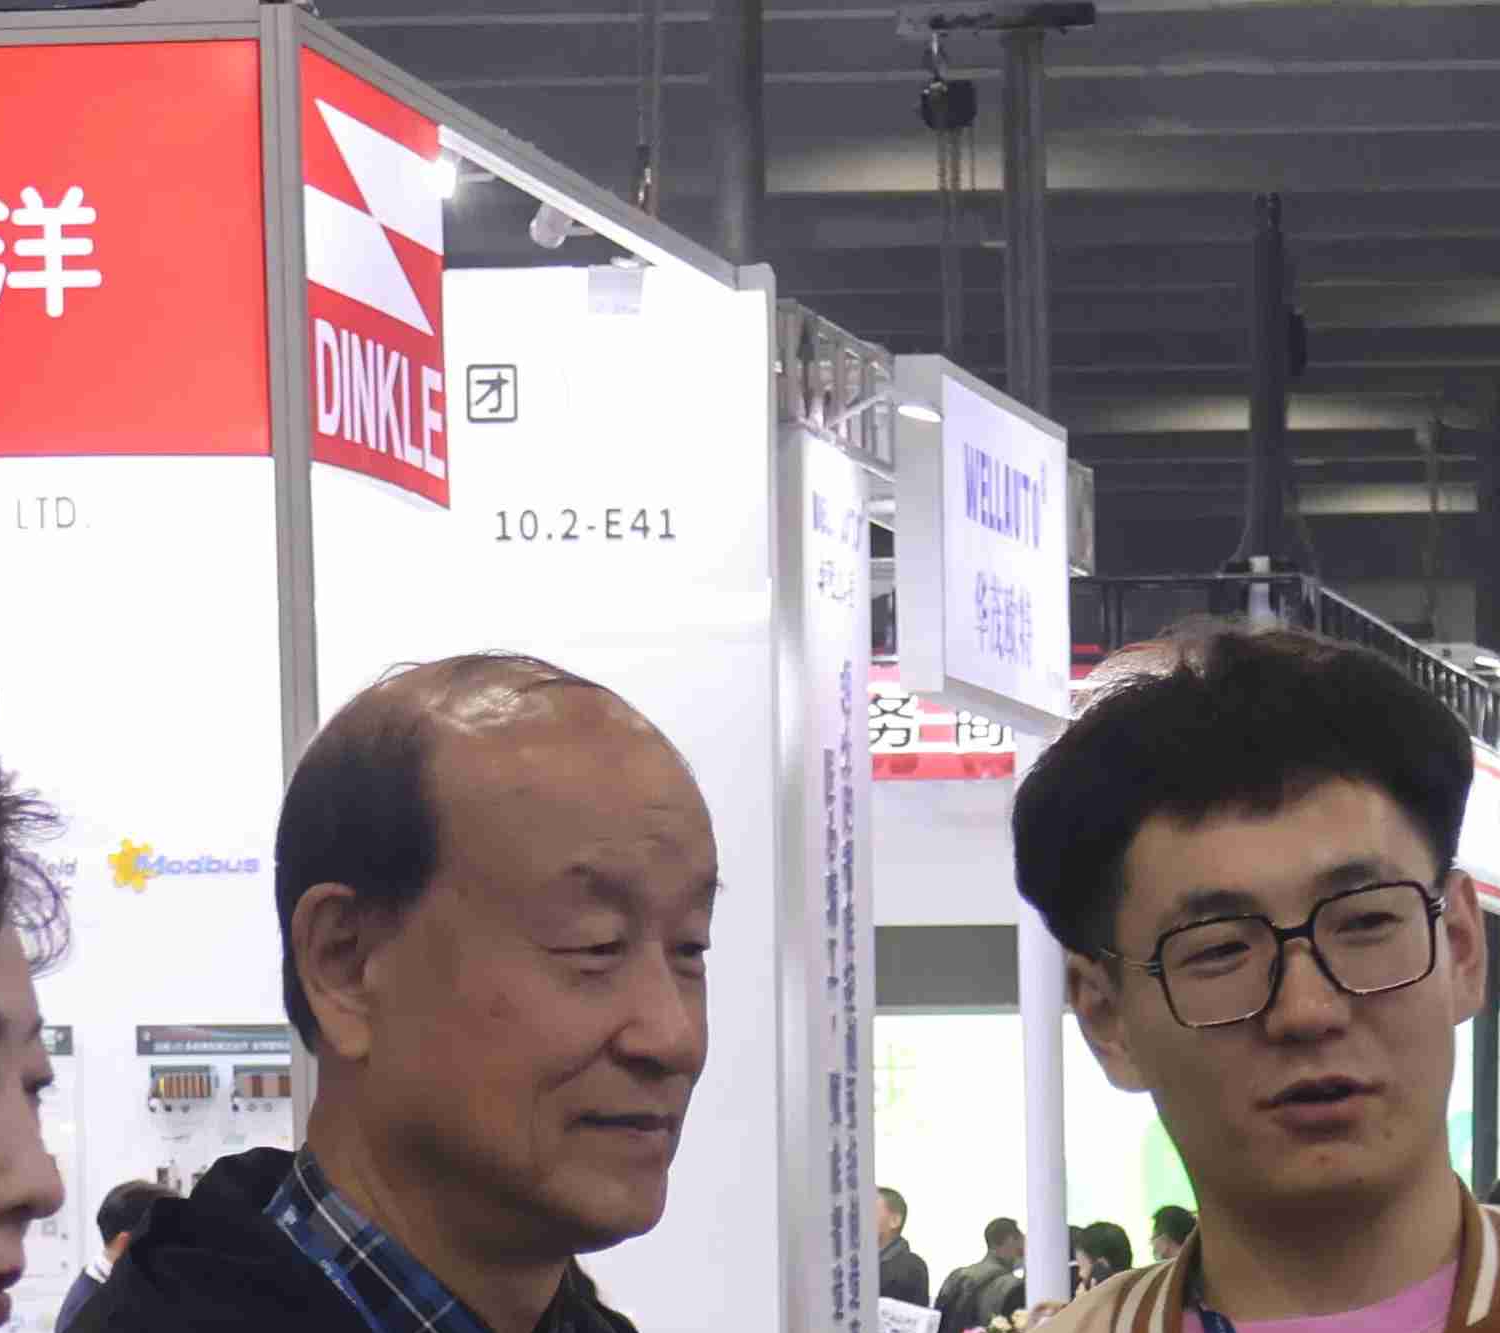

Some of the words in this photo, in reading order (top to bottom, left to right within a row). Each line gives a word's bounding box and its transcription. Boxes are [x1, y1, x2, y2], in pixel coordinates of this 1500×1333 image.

[314, 316, 446, 479] DINKLE
[16, 496, 92, 530] LTD.
[494, 507, 677, 543] 10.2-E41
[135, 854, 261, 876] Modbus
